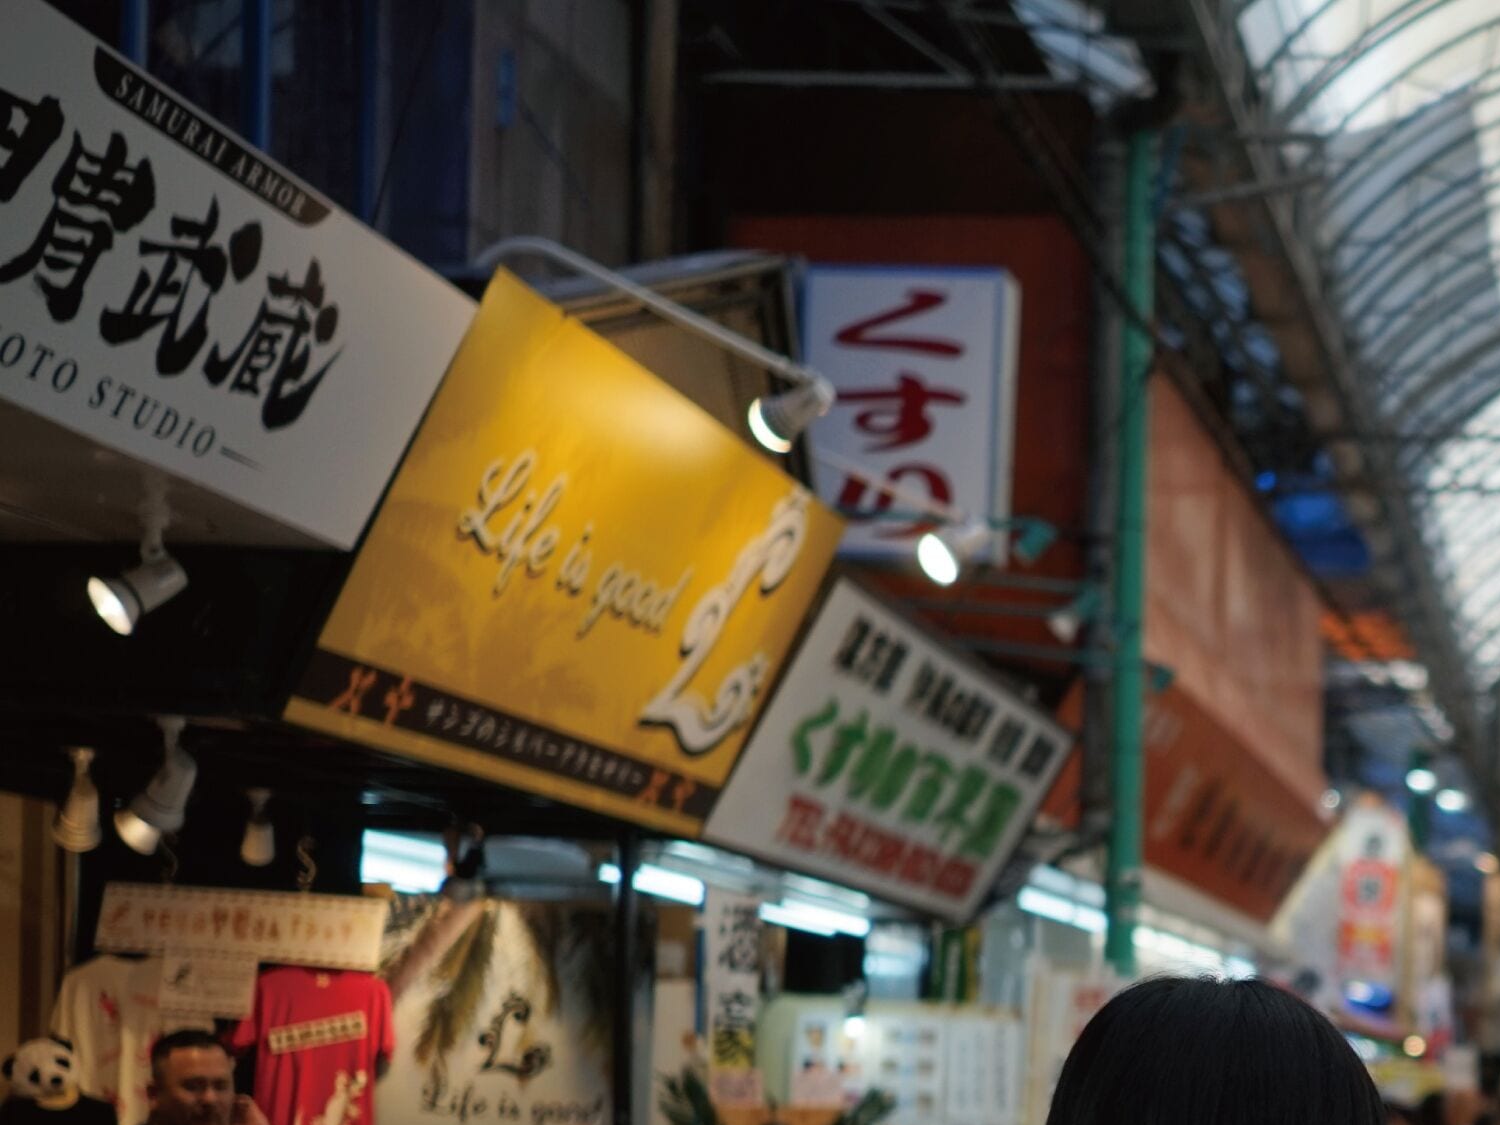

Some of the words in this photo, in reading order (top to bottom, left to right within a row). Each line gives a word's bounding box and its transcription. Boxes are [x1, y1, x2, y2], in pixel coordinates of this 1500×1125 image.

[115, 73, 227, 164] SAMURAI
[230, 150, 308, 217] ARMOR
[88, 376, 217, 454] STUDIO
[456, 448, 567, 598] Life
[557, 522, 594, 597] is
[576, 562, 695, 640] good
